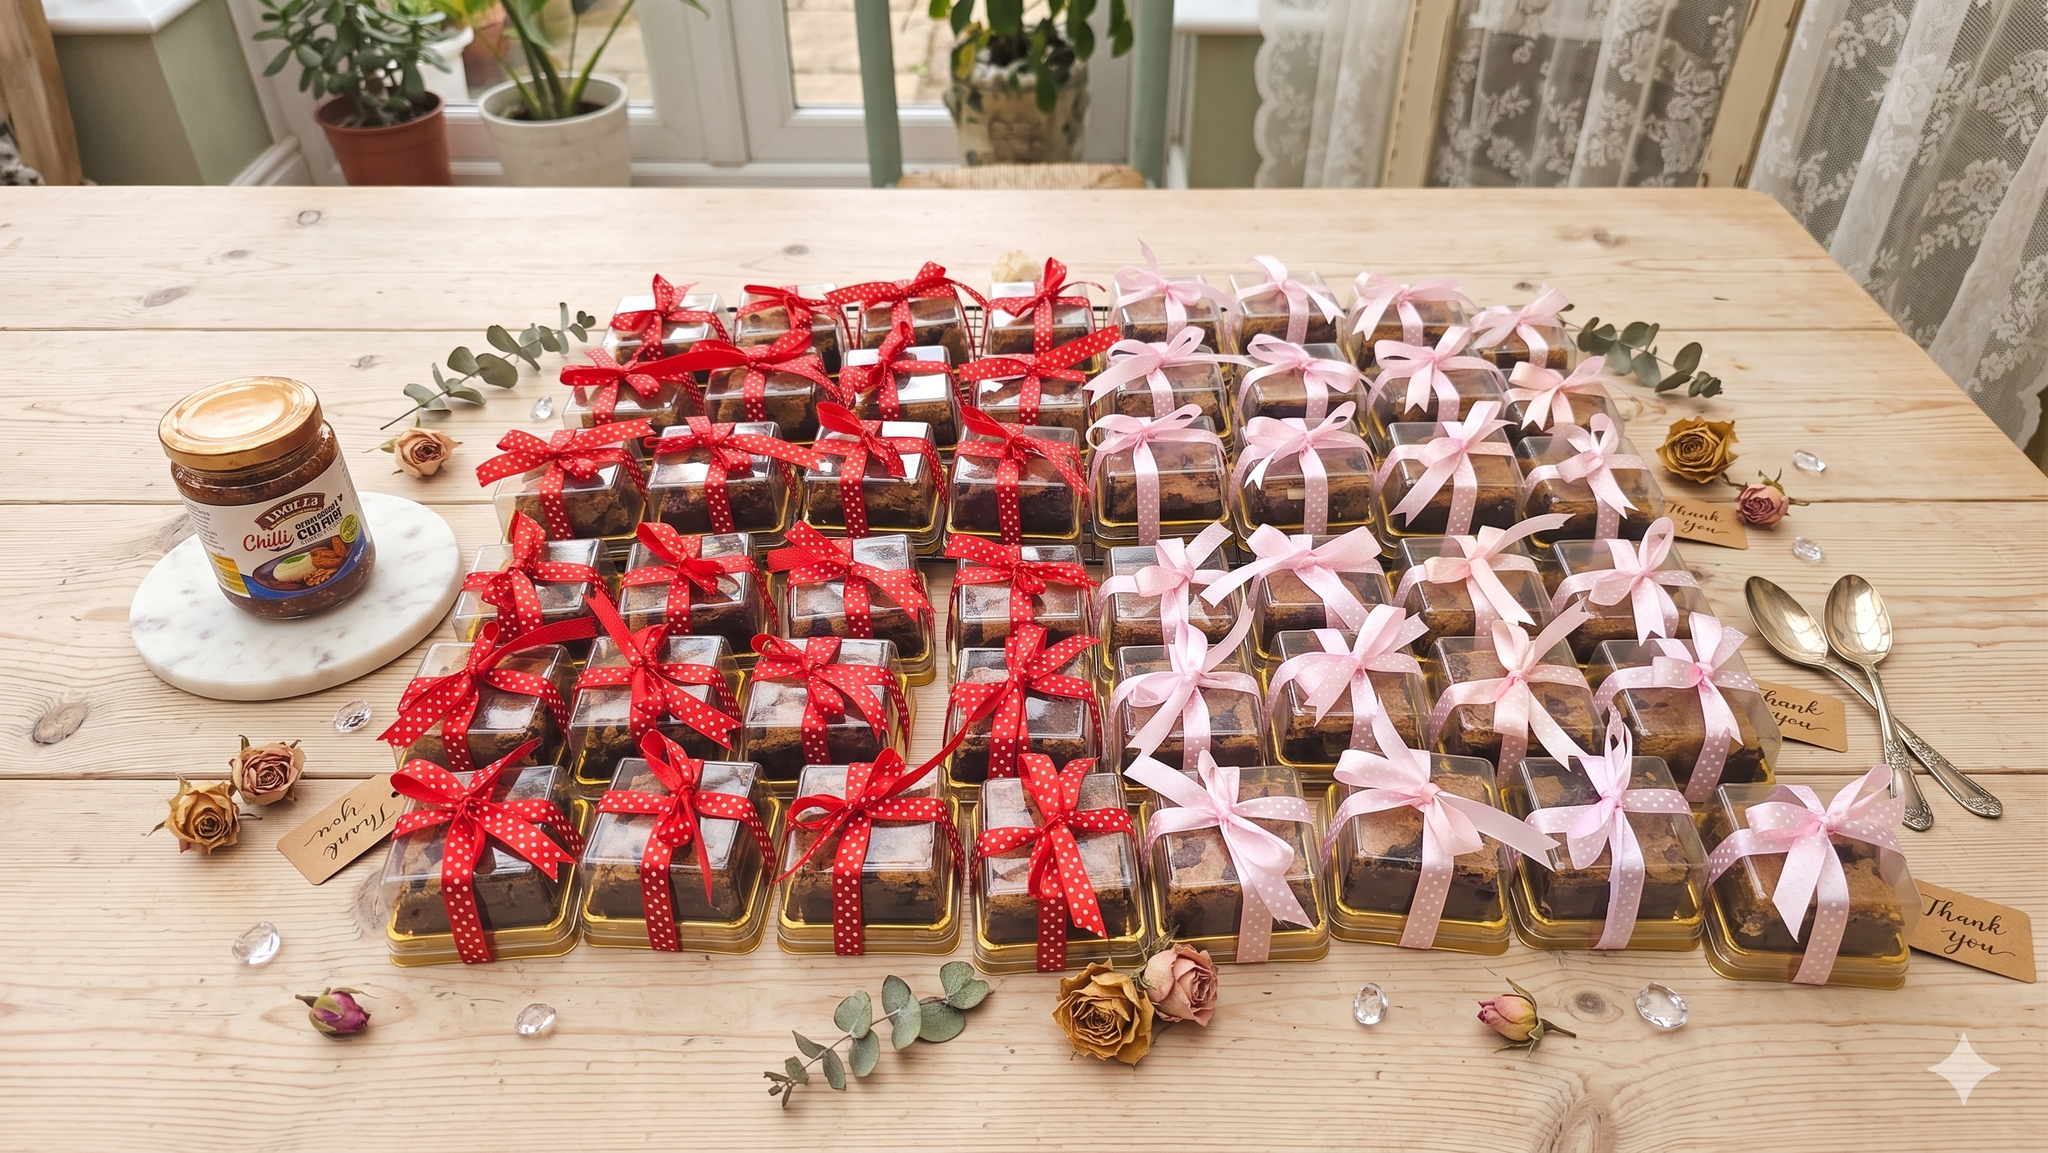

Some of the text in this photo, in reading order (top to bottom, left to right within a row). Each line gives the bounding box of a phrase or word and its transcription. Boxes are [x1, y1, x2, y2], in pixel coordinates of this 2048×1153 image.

[1666, 501, 1724, 523] Thank
[1678, 519, 1730, 534] you
[243, 530, 294, 552] Chilli
[1759, 688, 1824, 716] hank
[304, 797, 366, 847] you
[323, 804, 396, 860] Thank
[1921, 893, 2007, 935] Thank
[1940, 927, 2016, 957] you
